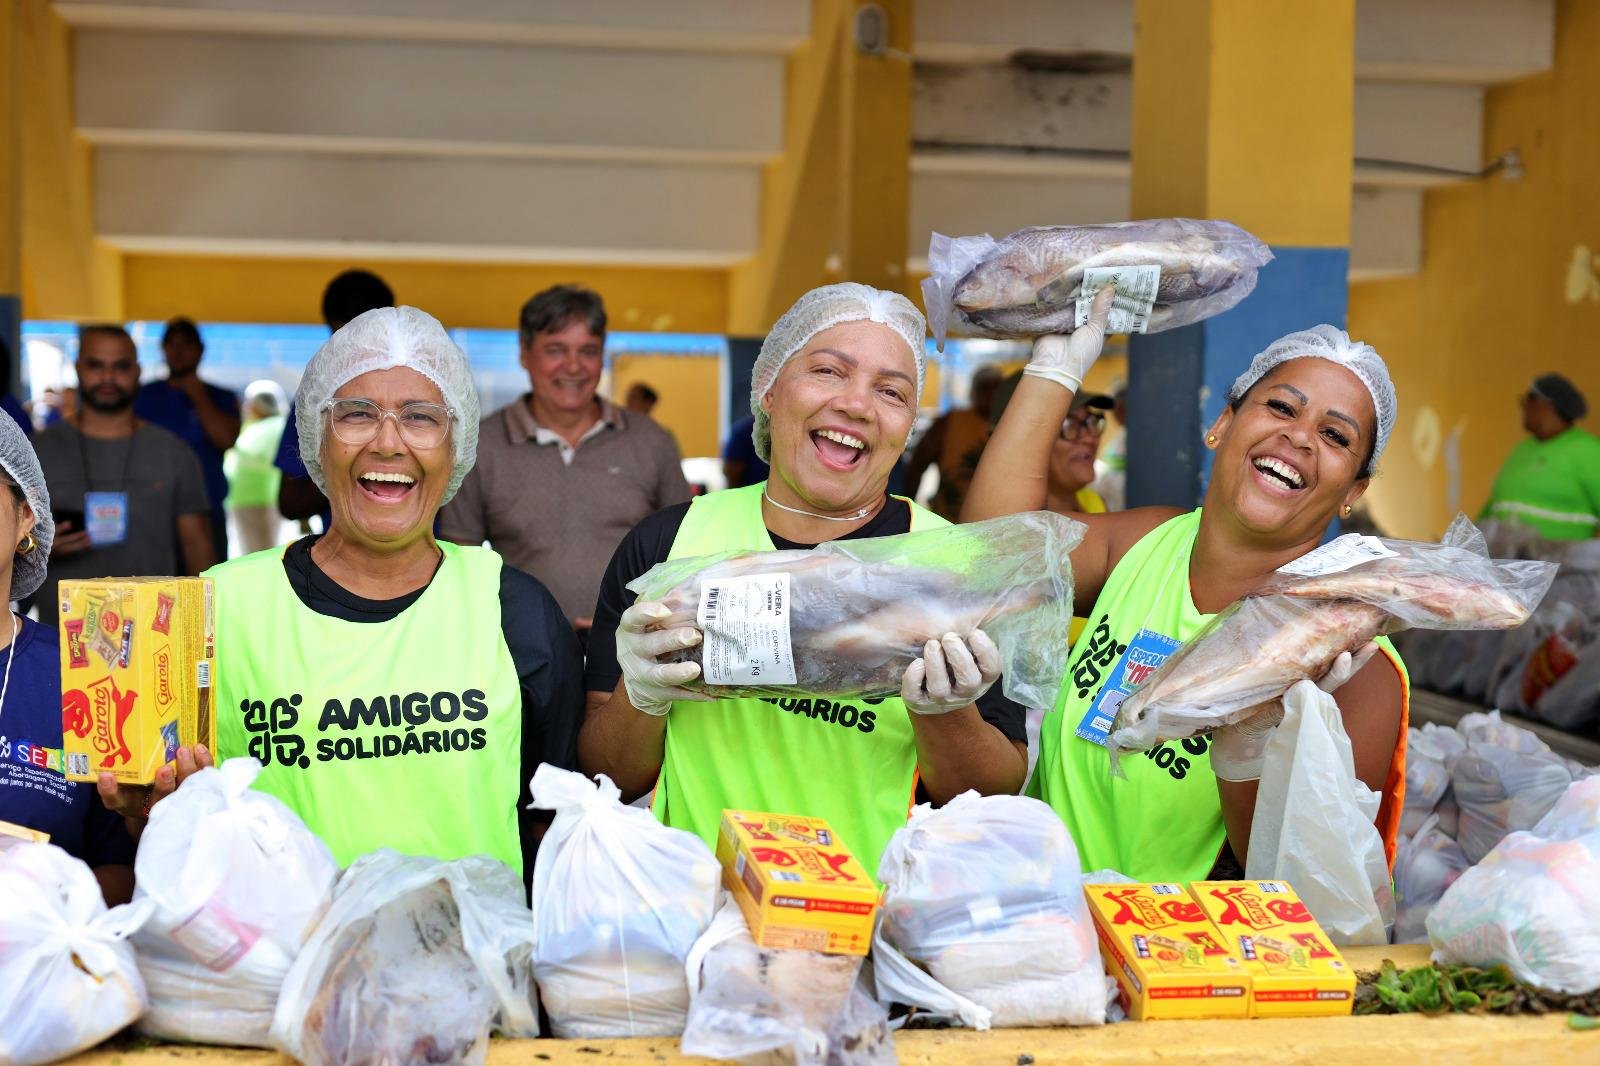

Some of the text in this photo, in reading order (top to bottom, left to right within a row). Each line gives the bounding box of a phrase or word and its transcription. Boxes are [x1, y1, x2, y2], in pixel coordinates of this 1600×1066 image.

[771, 629, 781, 665] CORVINA
[157, 655, 169, 706] Garoto
[751, 666, 761, 677] Kg
[92, 687, 111, 754] Garoto
[317, 688, 489, 732] AMIGOS
[316, 724, 487, 762] SOLIDÁRIOS
[0, 762, 22, 772] erviço
